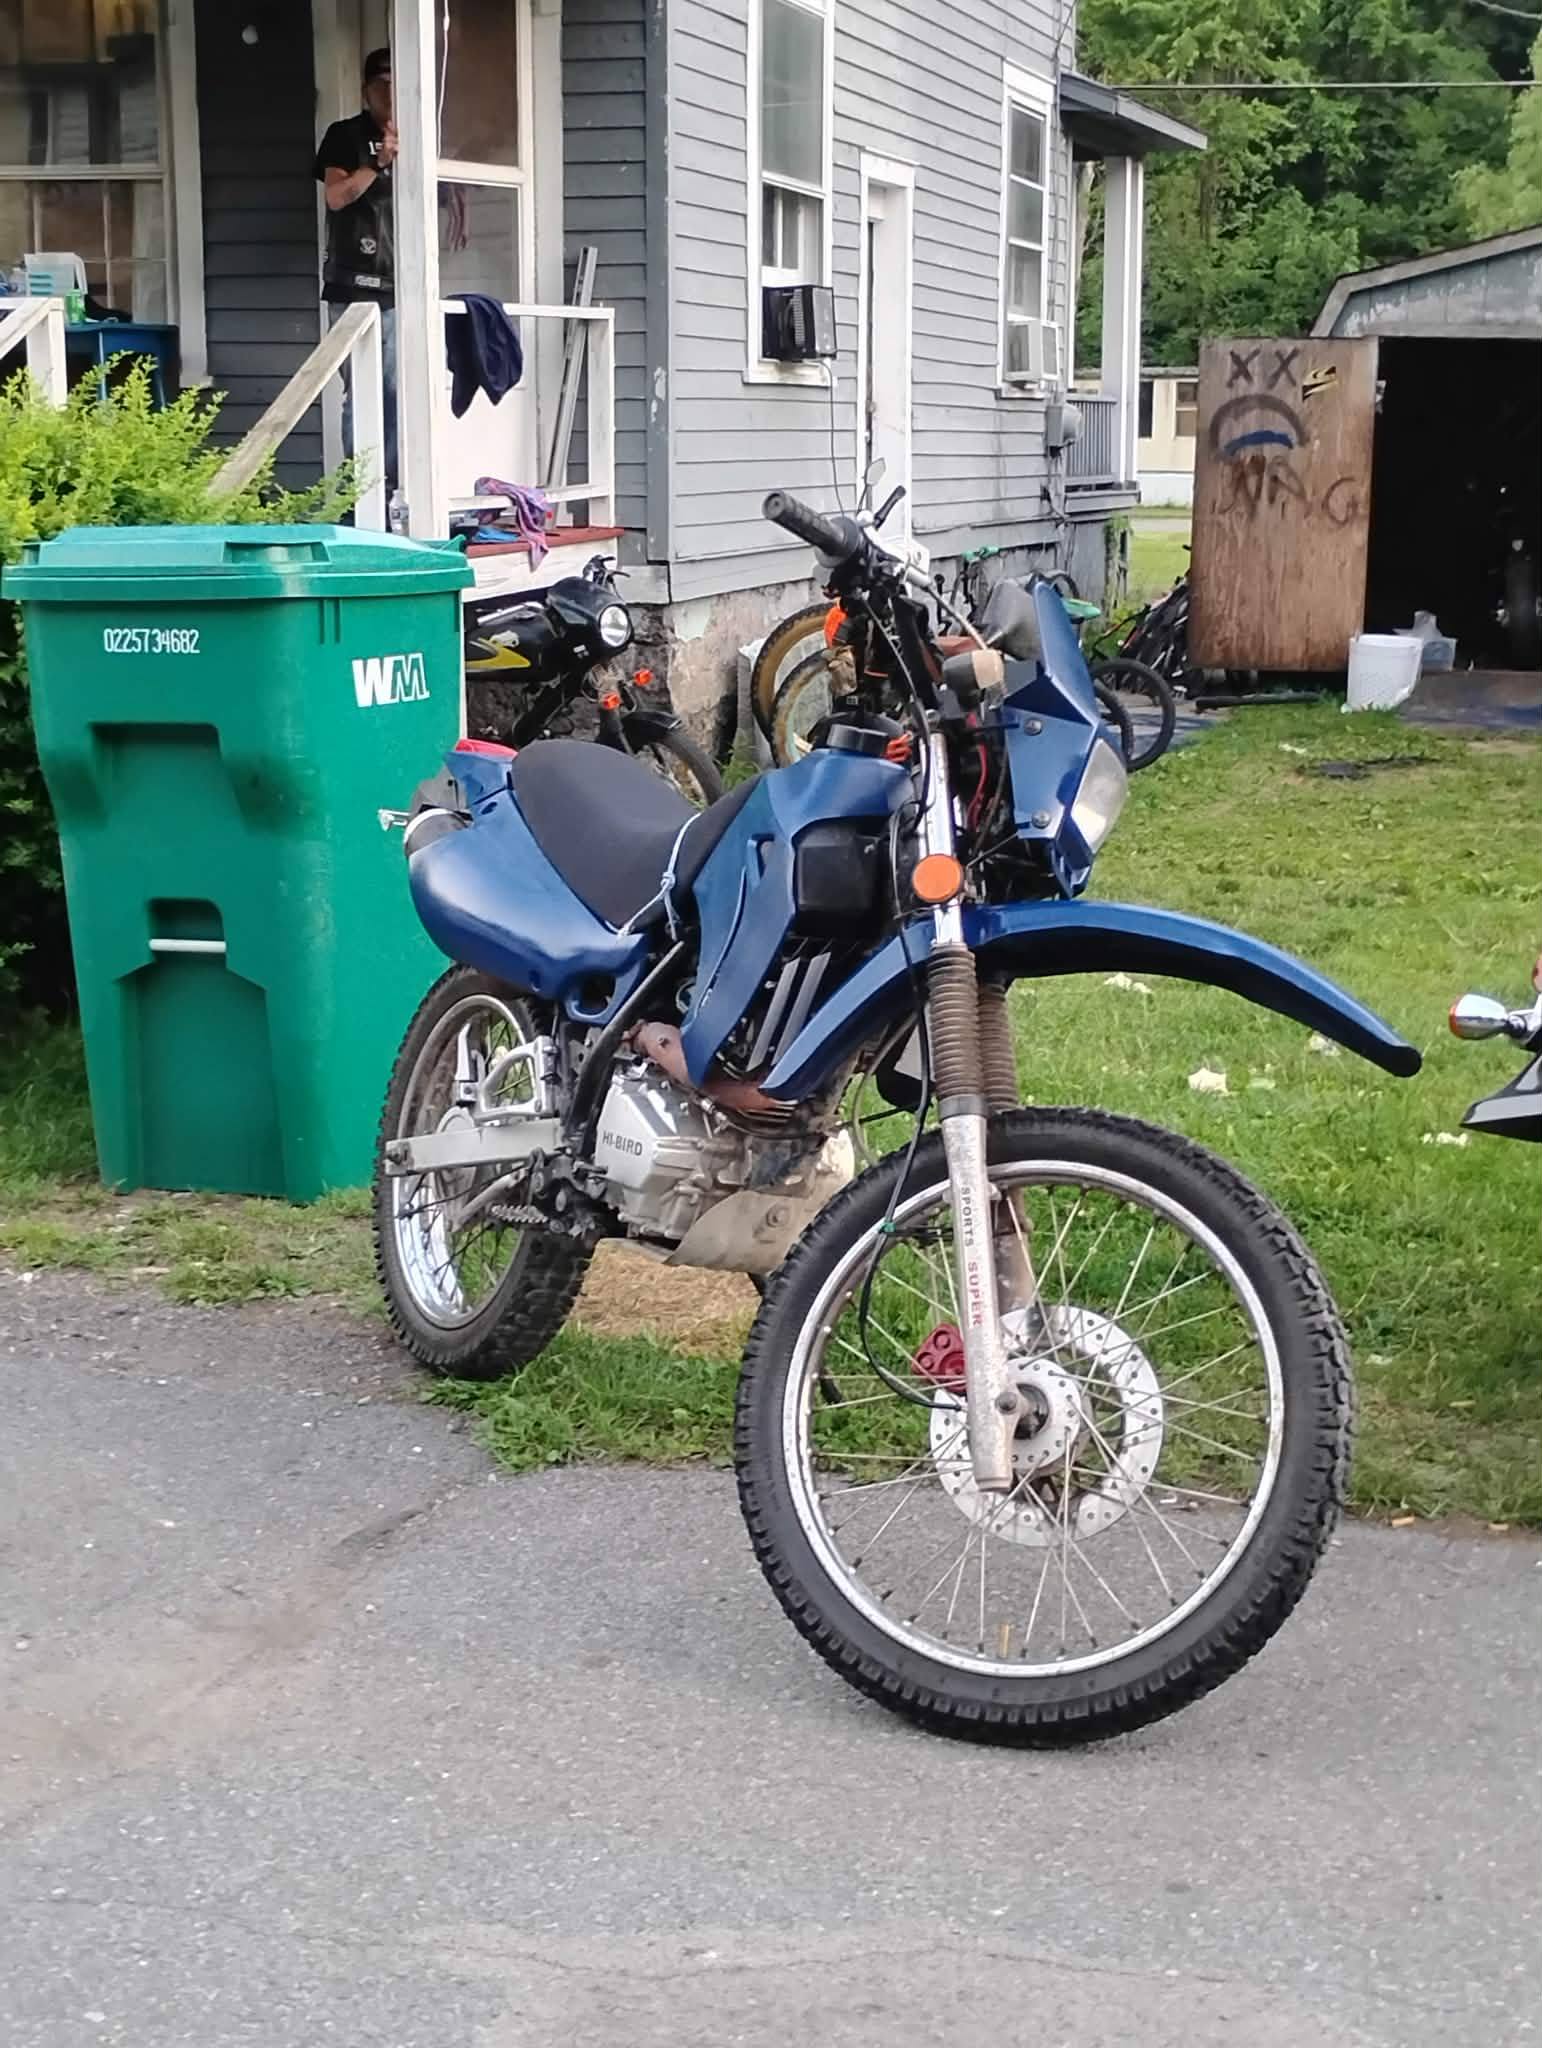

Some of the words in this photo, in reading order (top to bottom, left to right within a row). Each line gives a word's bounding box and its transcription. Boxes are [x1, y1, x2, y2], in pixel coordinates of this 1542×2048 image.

[103, 628, 201, 654] 0225734682
[352, 652, 431, 708] WM
[602, 1131, 643, 1156] HI-BIRD
[961, 1185, 975, 1247] SPORTS
[967, 1261, 984, 1326] SUPER
